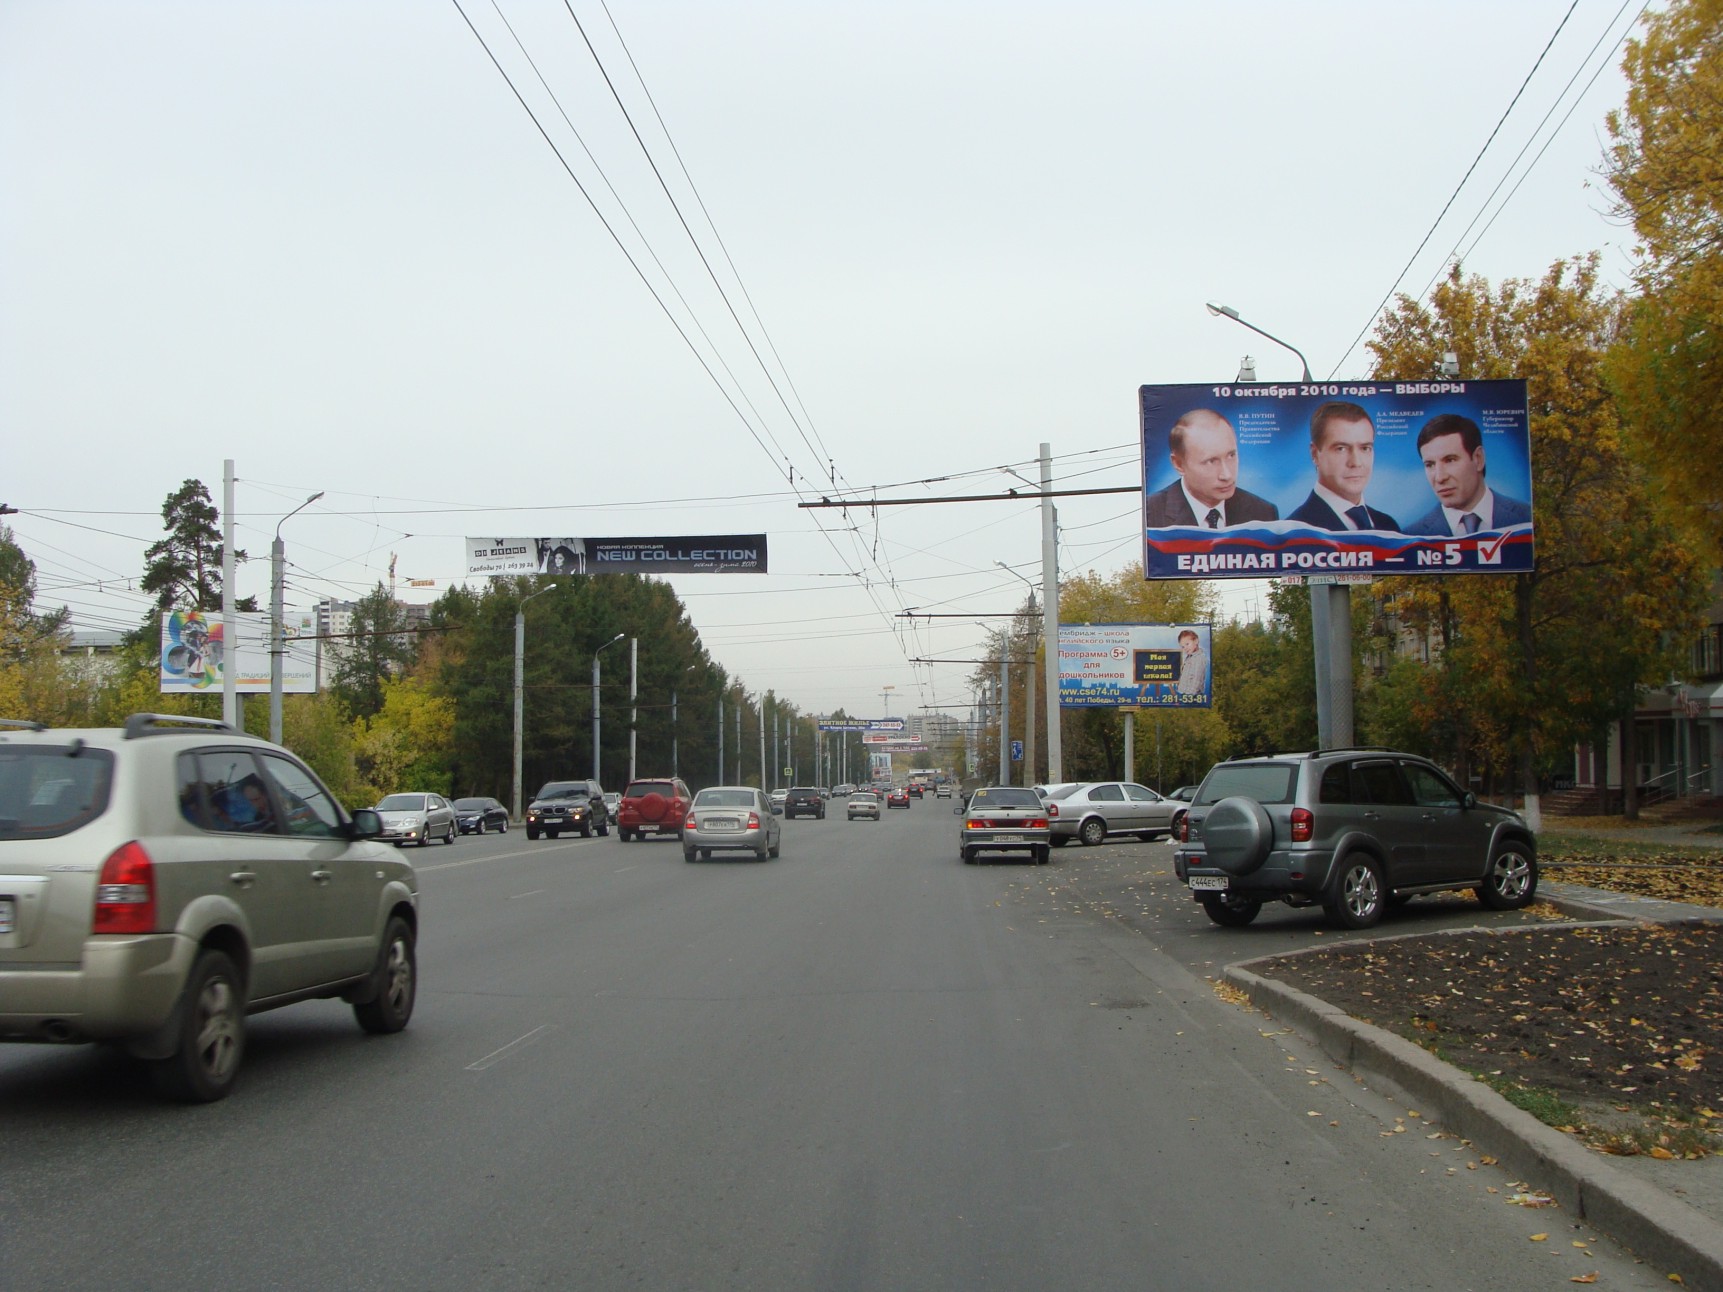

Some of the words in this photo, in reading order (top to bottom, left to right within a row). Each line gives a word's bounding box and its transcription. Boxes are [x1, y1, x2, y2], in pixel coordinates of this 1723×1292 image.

[1212, 386, 1231, 397] 10
[1234, 385, 1296, 399] октября
[1300, 385, 1340, 396] 2010
[1342, 385, 1376, 397] года
[1395, 383, 1466, 395] ВЫБОРЫ
[490, 546, 527, 556] JEANS
[596, 550, 636, 561] NEW
[640, 549, 757, 561] COLLECTION
[740, 560, 757, 568] 2010
[1177, 553, 1276, 573] ЕДИНАЯ
[1281, 551, 1374, 569] РОССИЯ
[469, 563, 495, 573] Свободы
[507, 562, 518, 570] 263
[518, 562, 526, 570] 39
[1058, 650, 1108, 660] Программа
[1112, 650, 1126, 658] 5+
[1136, 695, 1160, 703] тел.:
[1161, 694, 1208, 703] 281-53-81
